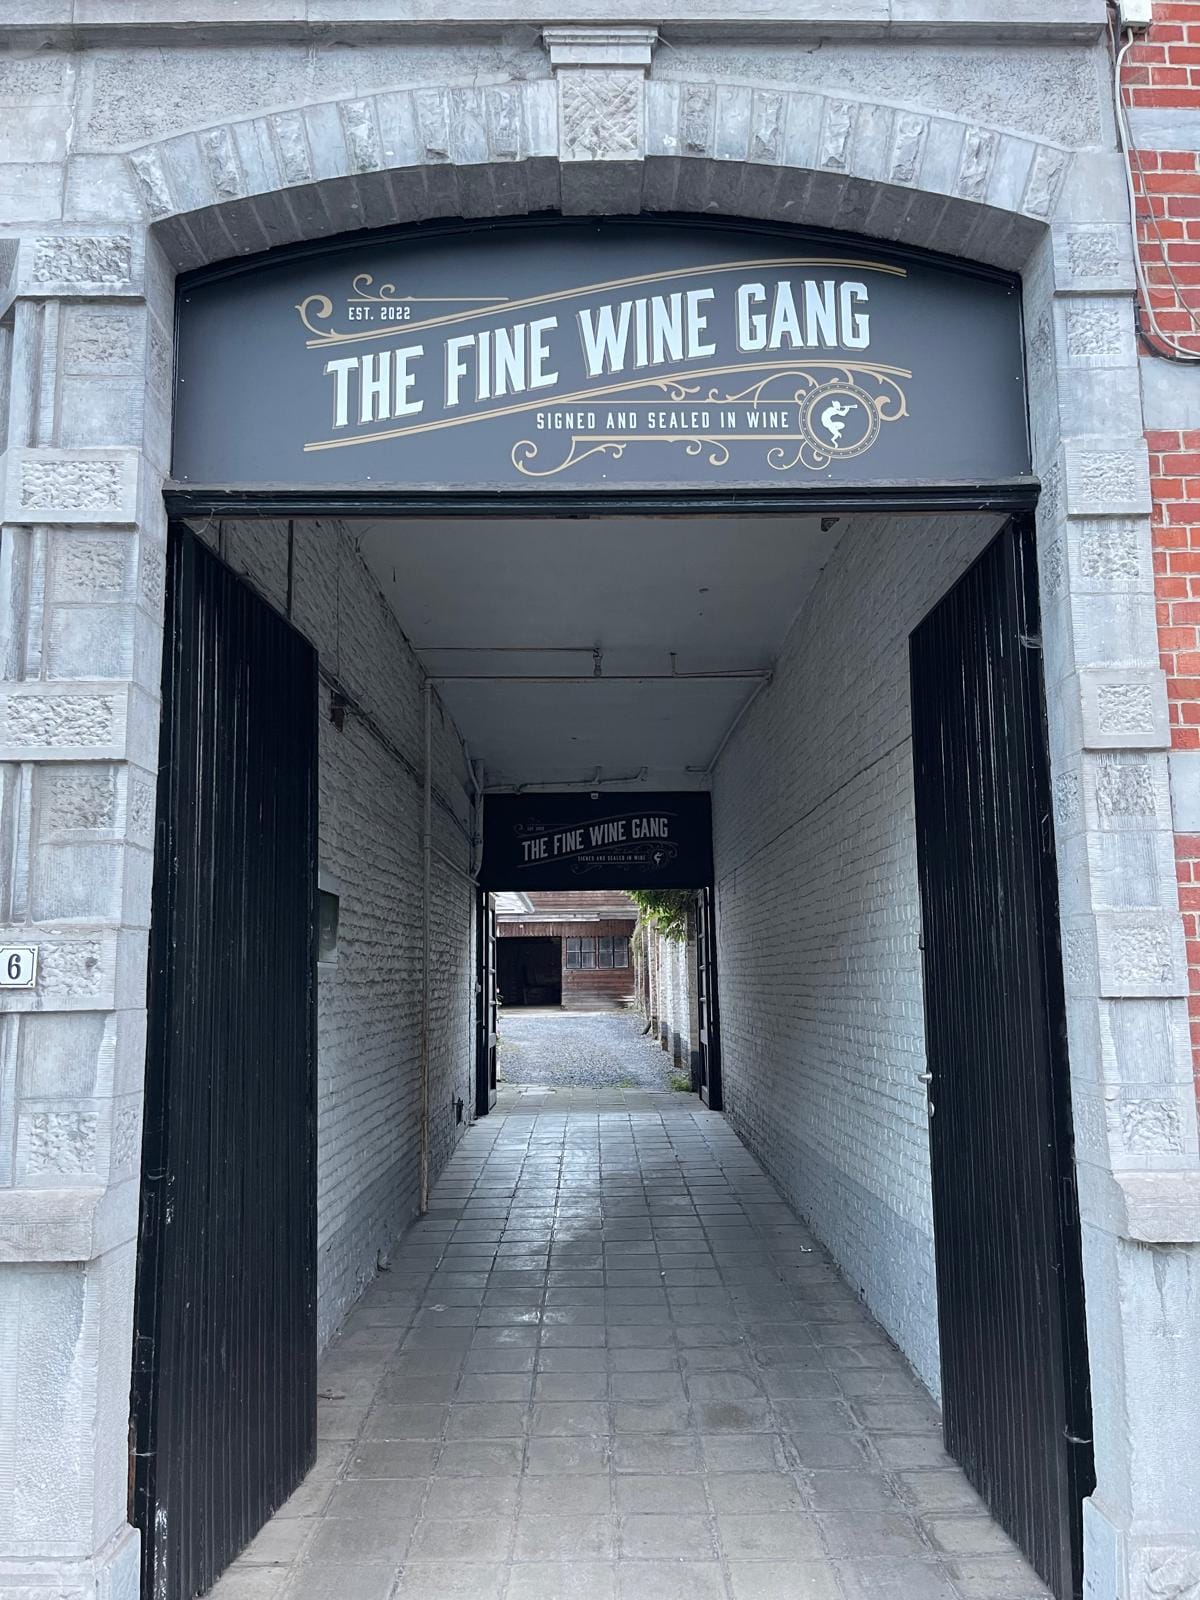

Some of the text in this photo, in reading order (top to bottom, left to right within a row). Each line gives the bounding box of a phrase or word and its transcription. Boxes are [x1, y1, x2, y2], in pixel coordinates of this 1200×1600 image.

[348, 306, 411, 320] EST. 2022
[324, 279, 871, 429] THE FINE WINE GANG
[536, 411, 789, 429] SIGNED AND SEALED IN WINE
[521, 817, 669, 861] THE FINE WINE GANG
[7, 953, 22, 980] 6
